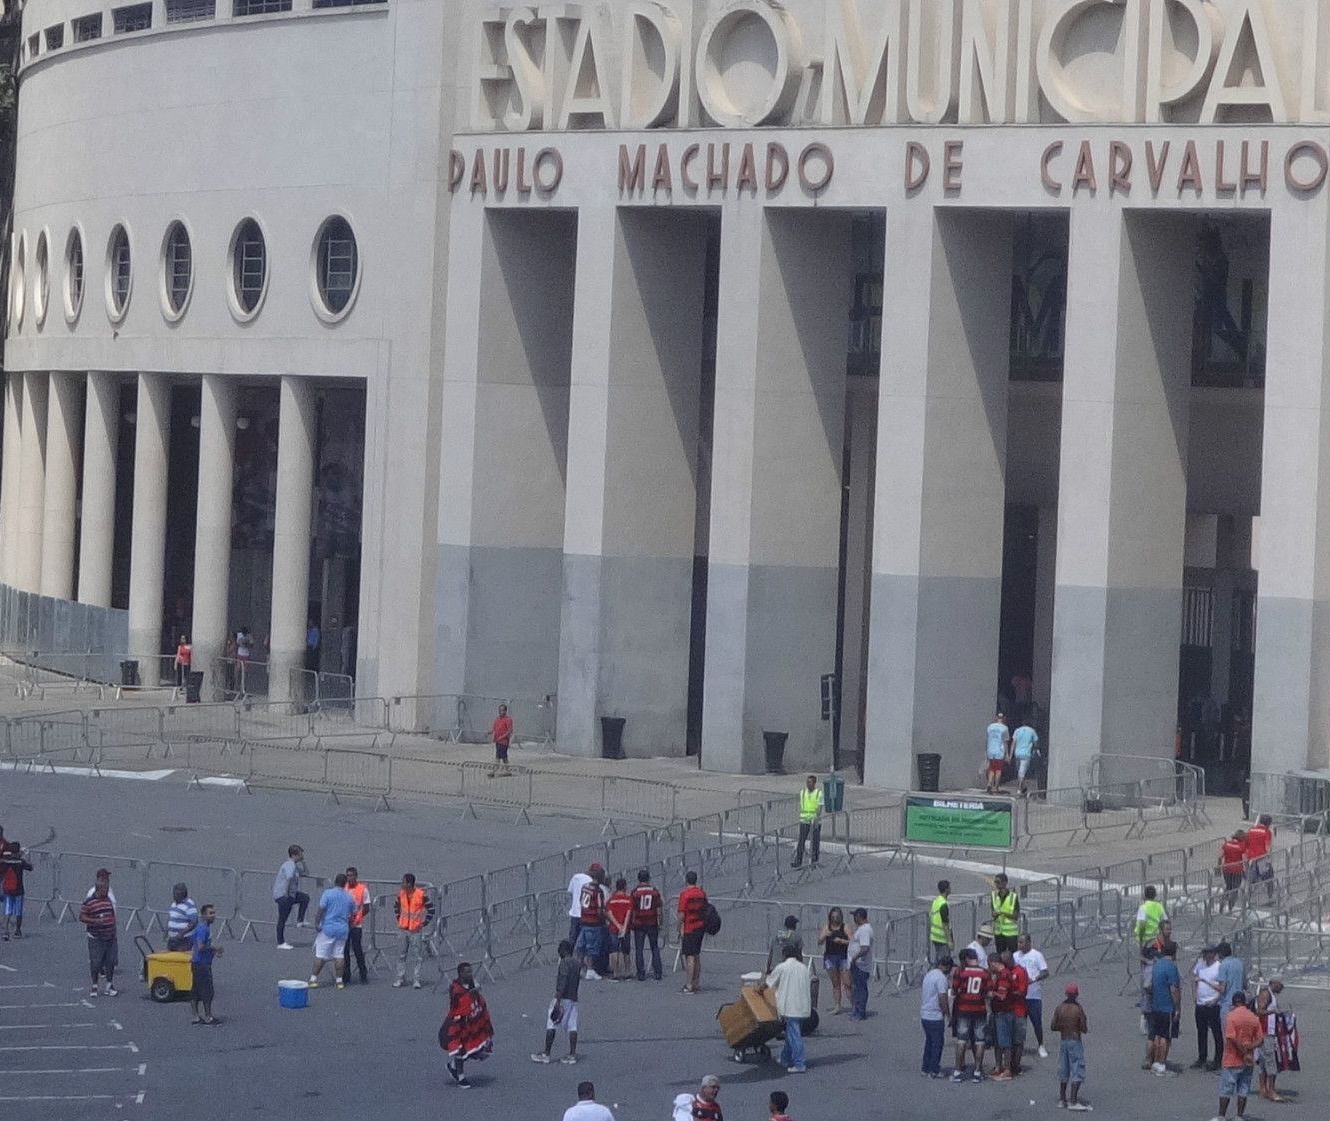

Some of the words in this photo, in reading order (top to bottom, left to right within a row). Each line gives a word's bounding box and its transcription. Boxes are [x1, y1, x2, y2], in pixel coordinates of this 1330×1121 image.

[447, 146, 564, 194] PAULO
[617, 141, 835, 194] MACHADO
[904, 140, 964, 192] DE
[1040, 139, 1329, 194] CARVALHO
[640, 894, 652, 910] 10
[967, 976, 982, 994] 10
